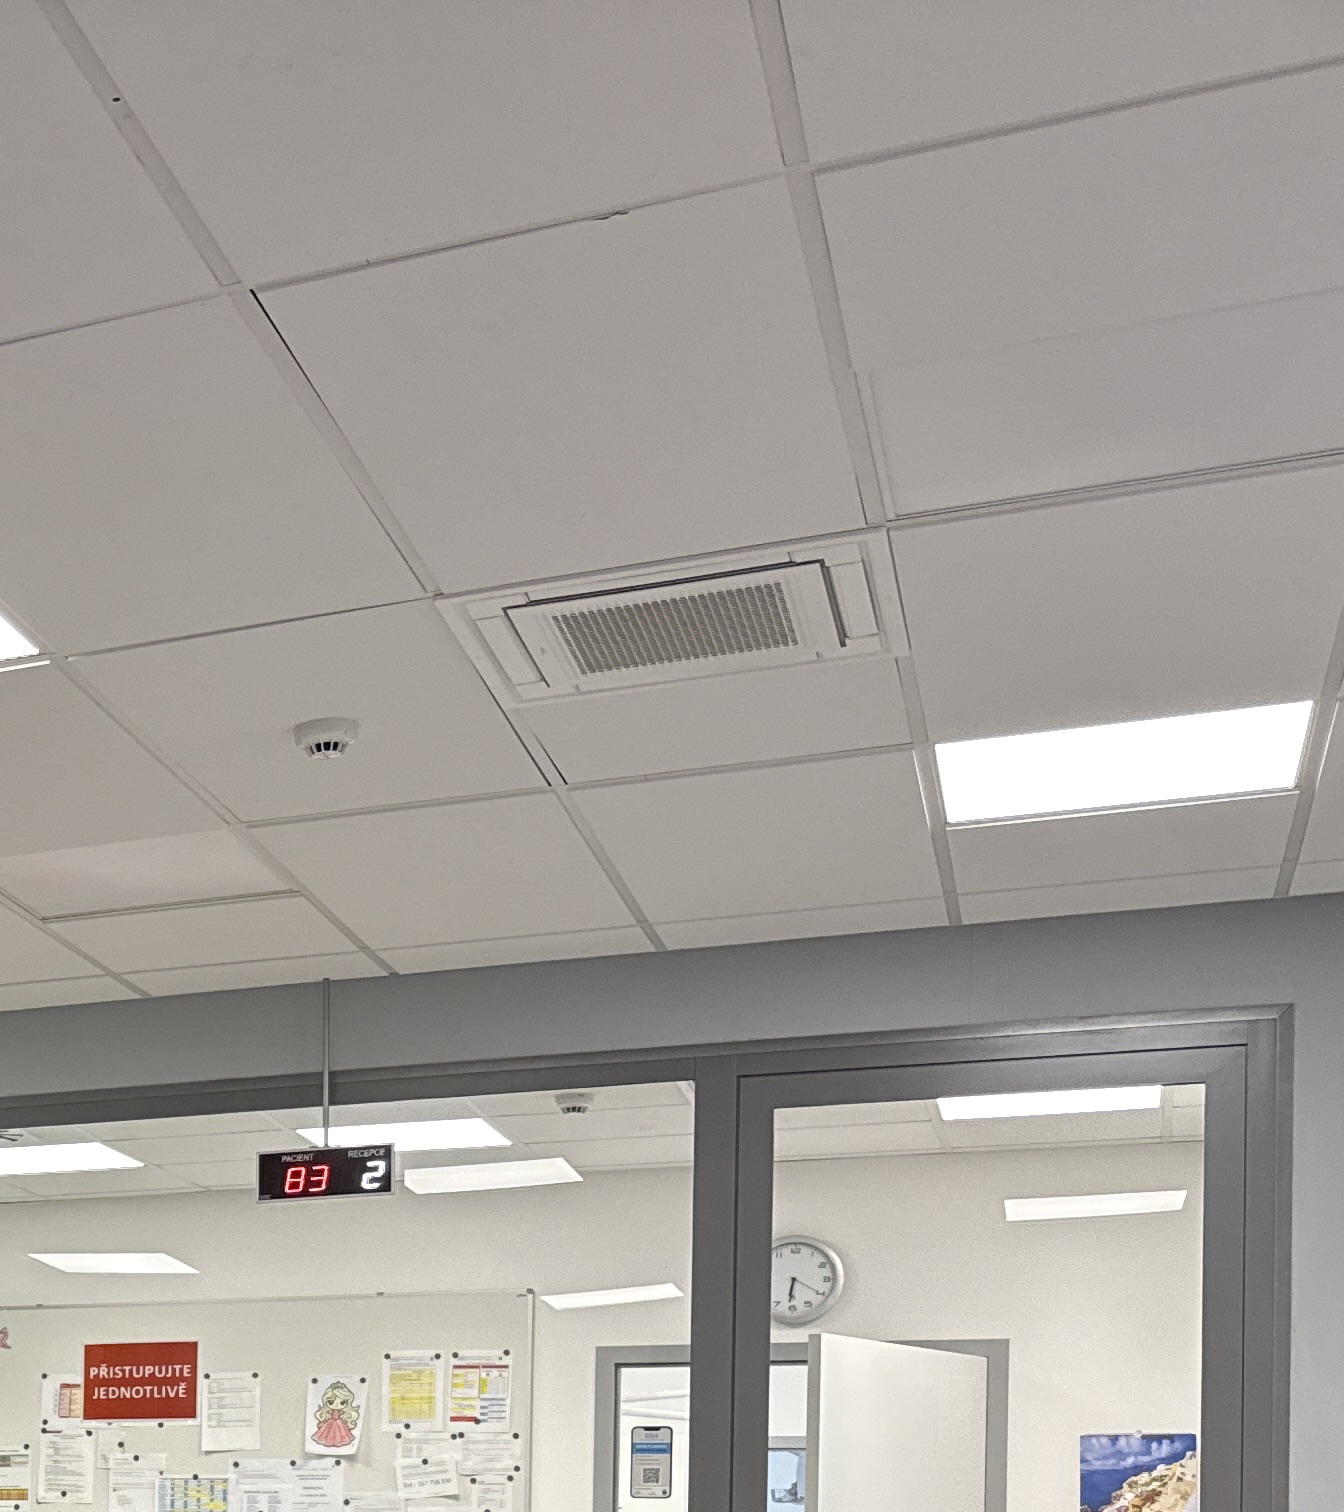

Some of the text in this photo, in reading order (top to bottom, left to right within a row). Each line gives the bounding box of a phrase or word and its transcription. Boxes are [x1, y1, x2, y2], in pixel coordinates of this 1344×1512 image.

[281, 1148, 385, 1162] PACIENT RECEPCE
[285, 1160, 386, 1193] 83 2
[89, 1363, 192, 1379] PŘISTUPUJTE
[92, 1382, 187, 1400] JEDNOTLIVĚ
